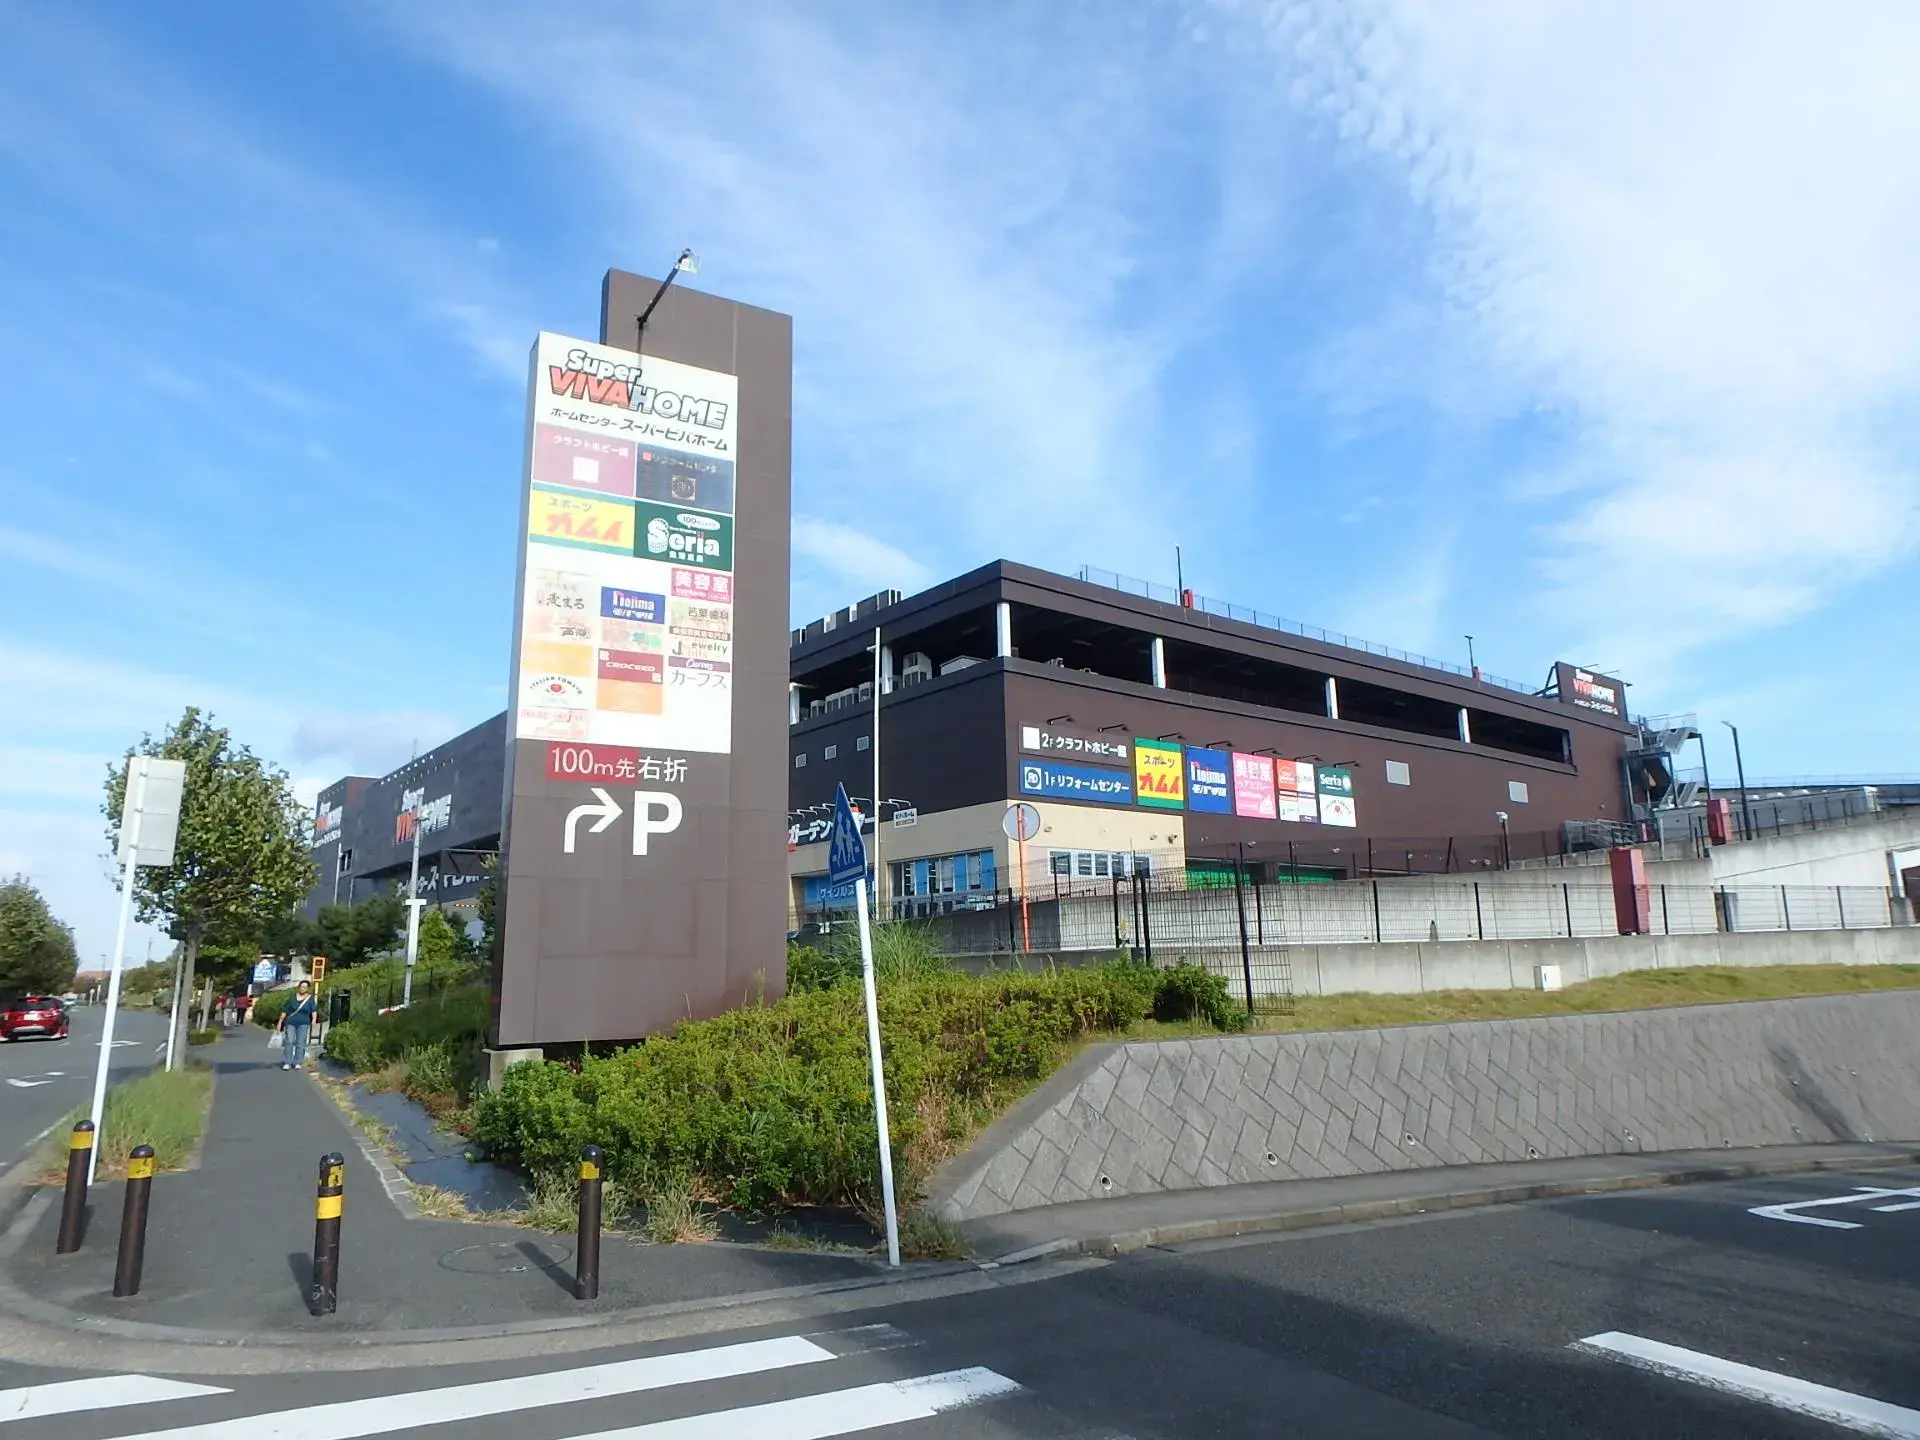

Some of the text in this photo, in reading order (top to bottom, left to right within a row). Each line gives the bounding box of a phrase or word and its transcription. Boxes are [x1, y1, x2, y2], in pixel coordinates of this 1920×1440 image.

[565, 349, 642, 383] Super
[550, 407, 728, 451] ホームセンター スーパービバホーム
[647, 517, 720, 558] Seria
[1143, 754, 1175, 769] スポーツ
[1058, 774, 1130, 793] リフォームセンター
[1320, 773, 1341, 787] Seria
[632, 790, 683, 855] P
